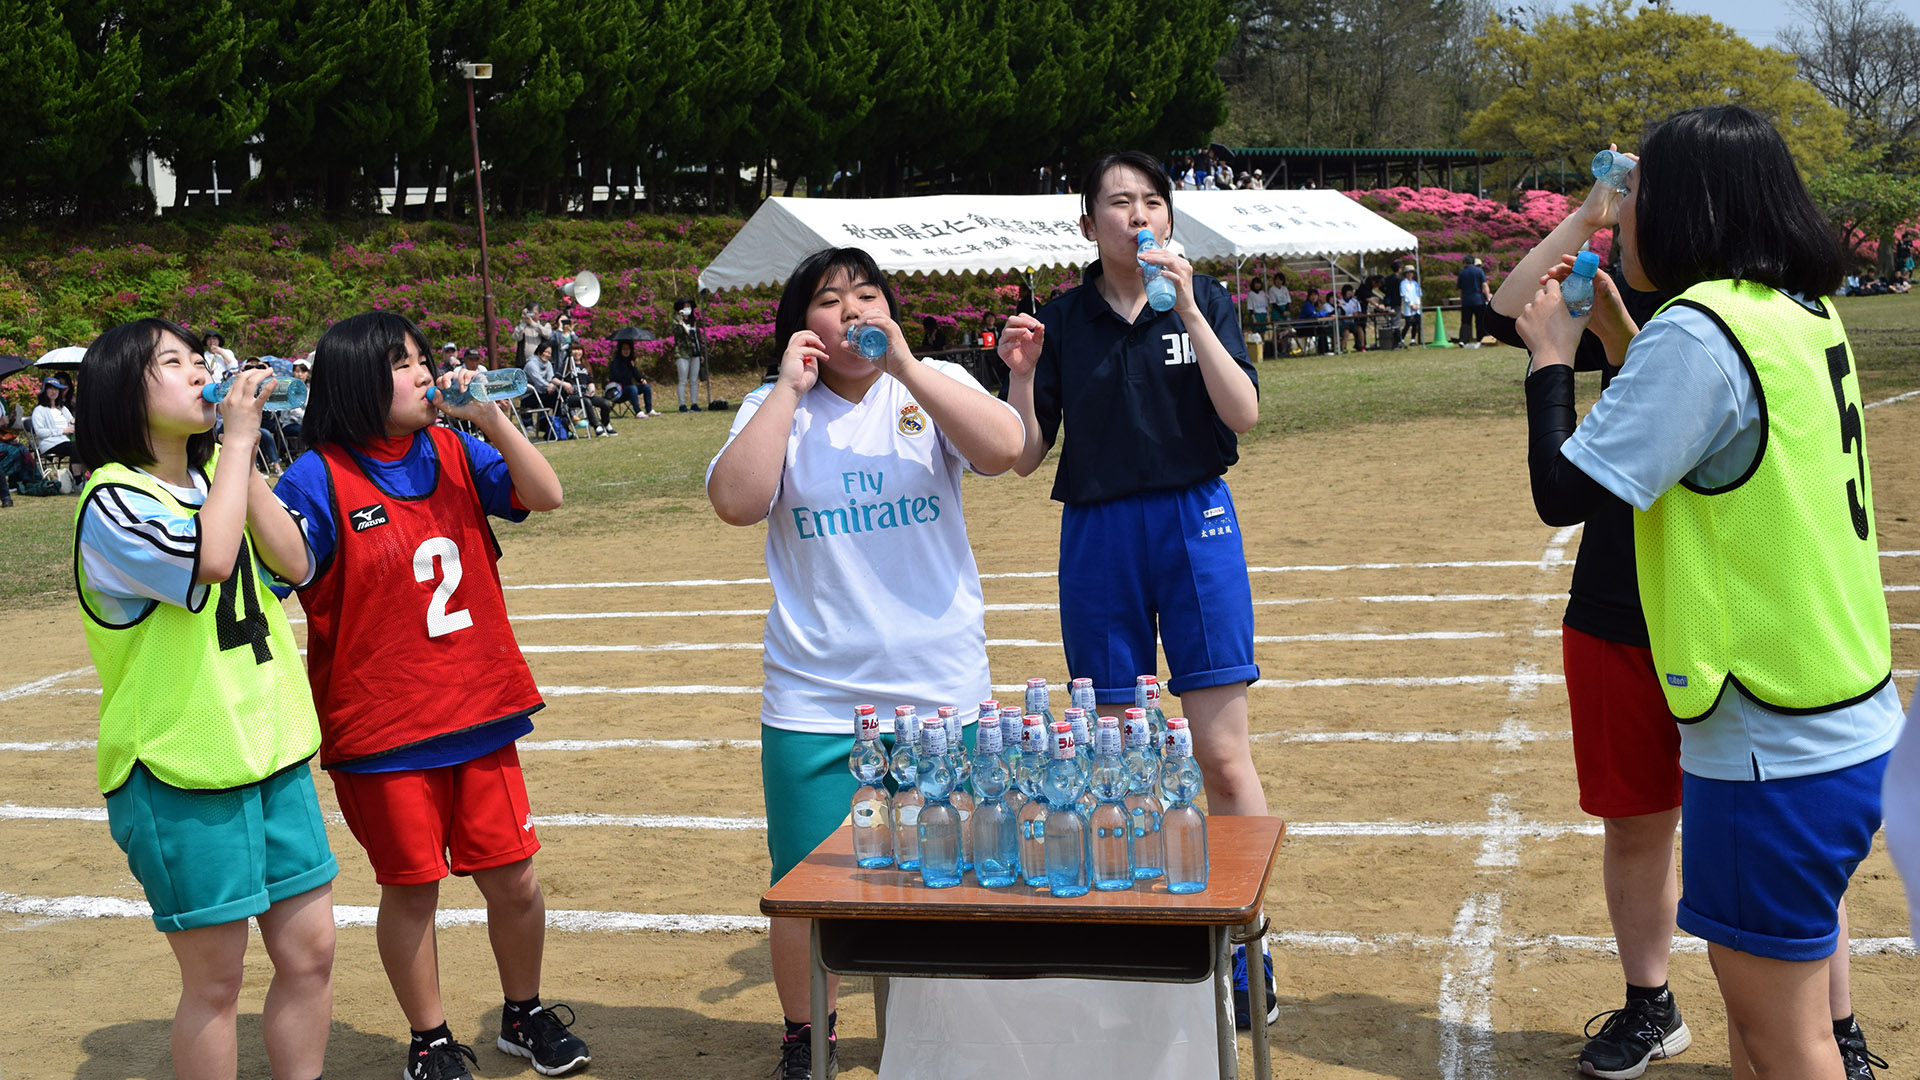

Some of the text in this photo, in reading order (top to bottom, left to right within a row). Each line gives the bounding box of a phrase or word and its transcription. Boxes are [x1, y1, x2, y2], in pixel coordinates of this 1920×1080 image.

[842, 471, 883, 495] Fly
[1825, 341, 1869, 541] 5
[791, 493, 940, 539] Emirates
[215, 531, 274, 665] 4
[413, 536, 474, 638] 2
